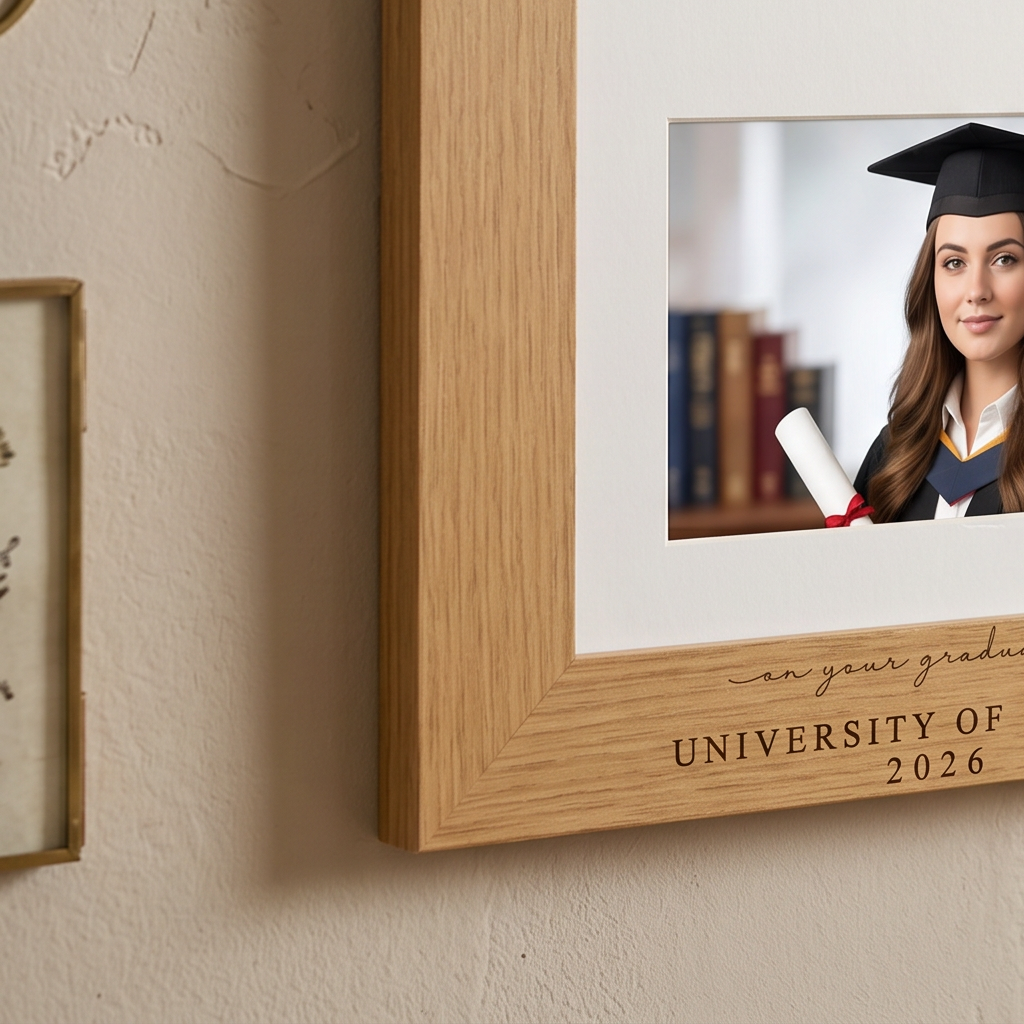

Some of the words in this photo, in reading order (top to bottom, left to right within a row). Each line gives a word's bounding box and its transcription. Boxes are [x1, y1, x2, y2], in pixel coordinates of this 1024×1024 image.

[728, 667, 813, 685] on
[814, 657, 910, 698] your
[672, 711, 936, 768] UNIVERSITY
[955, 704, 1004, 735] OF
[886, 746, 986, 785] 2026
